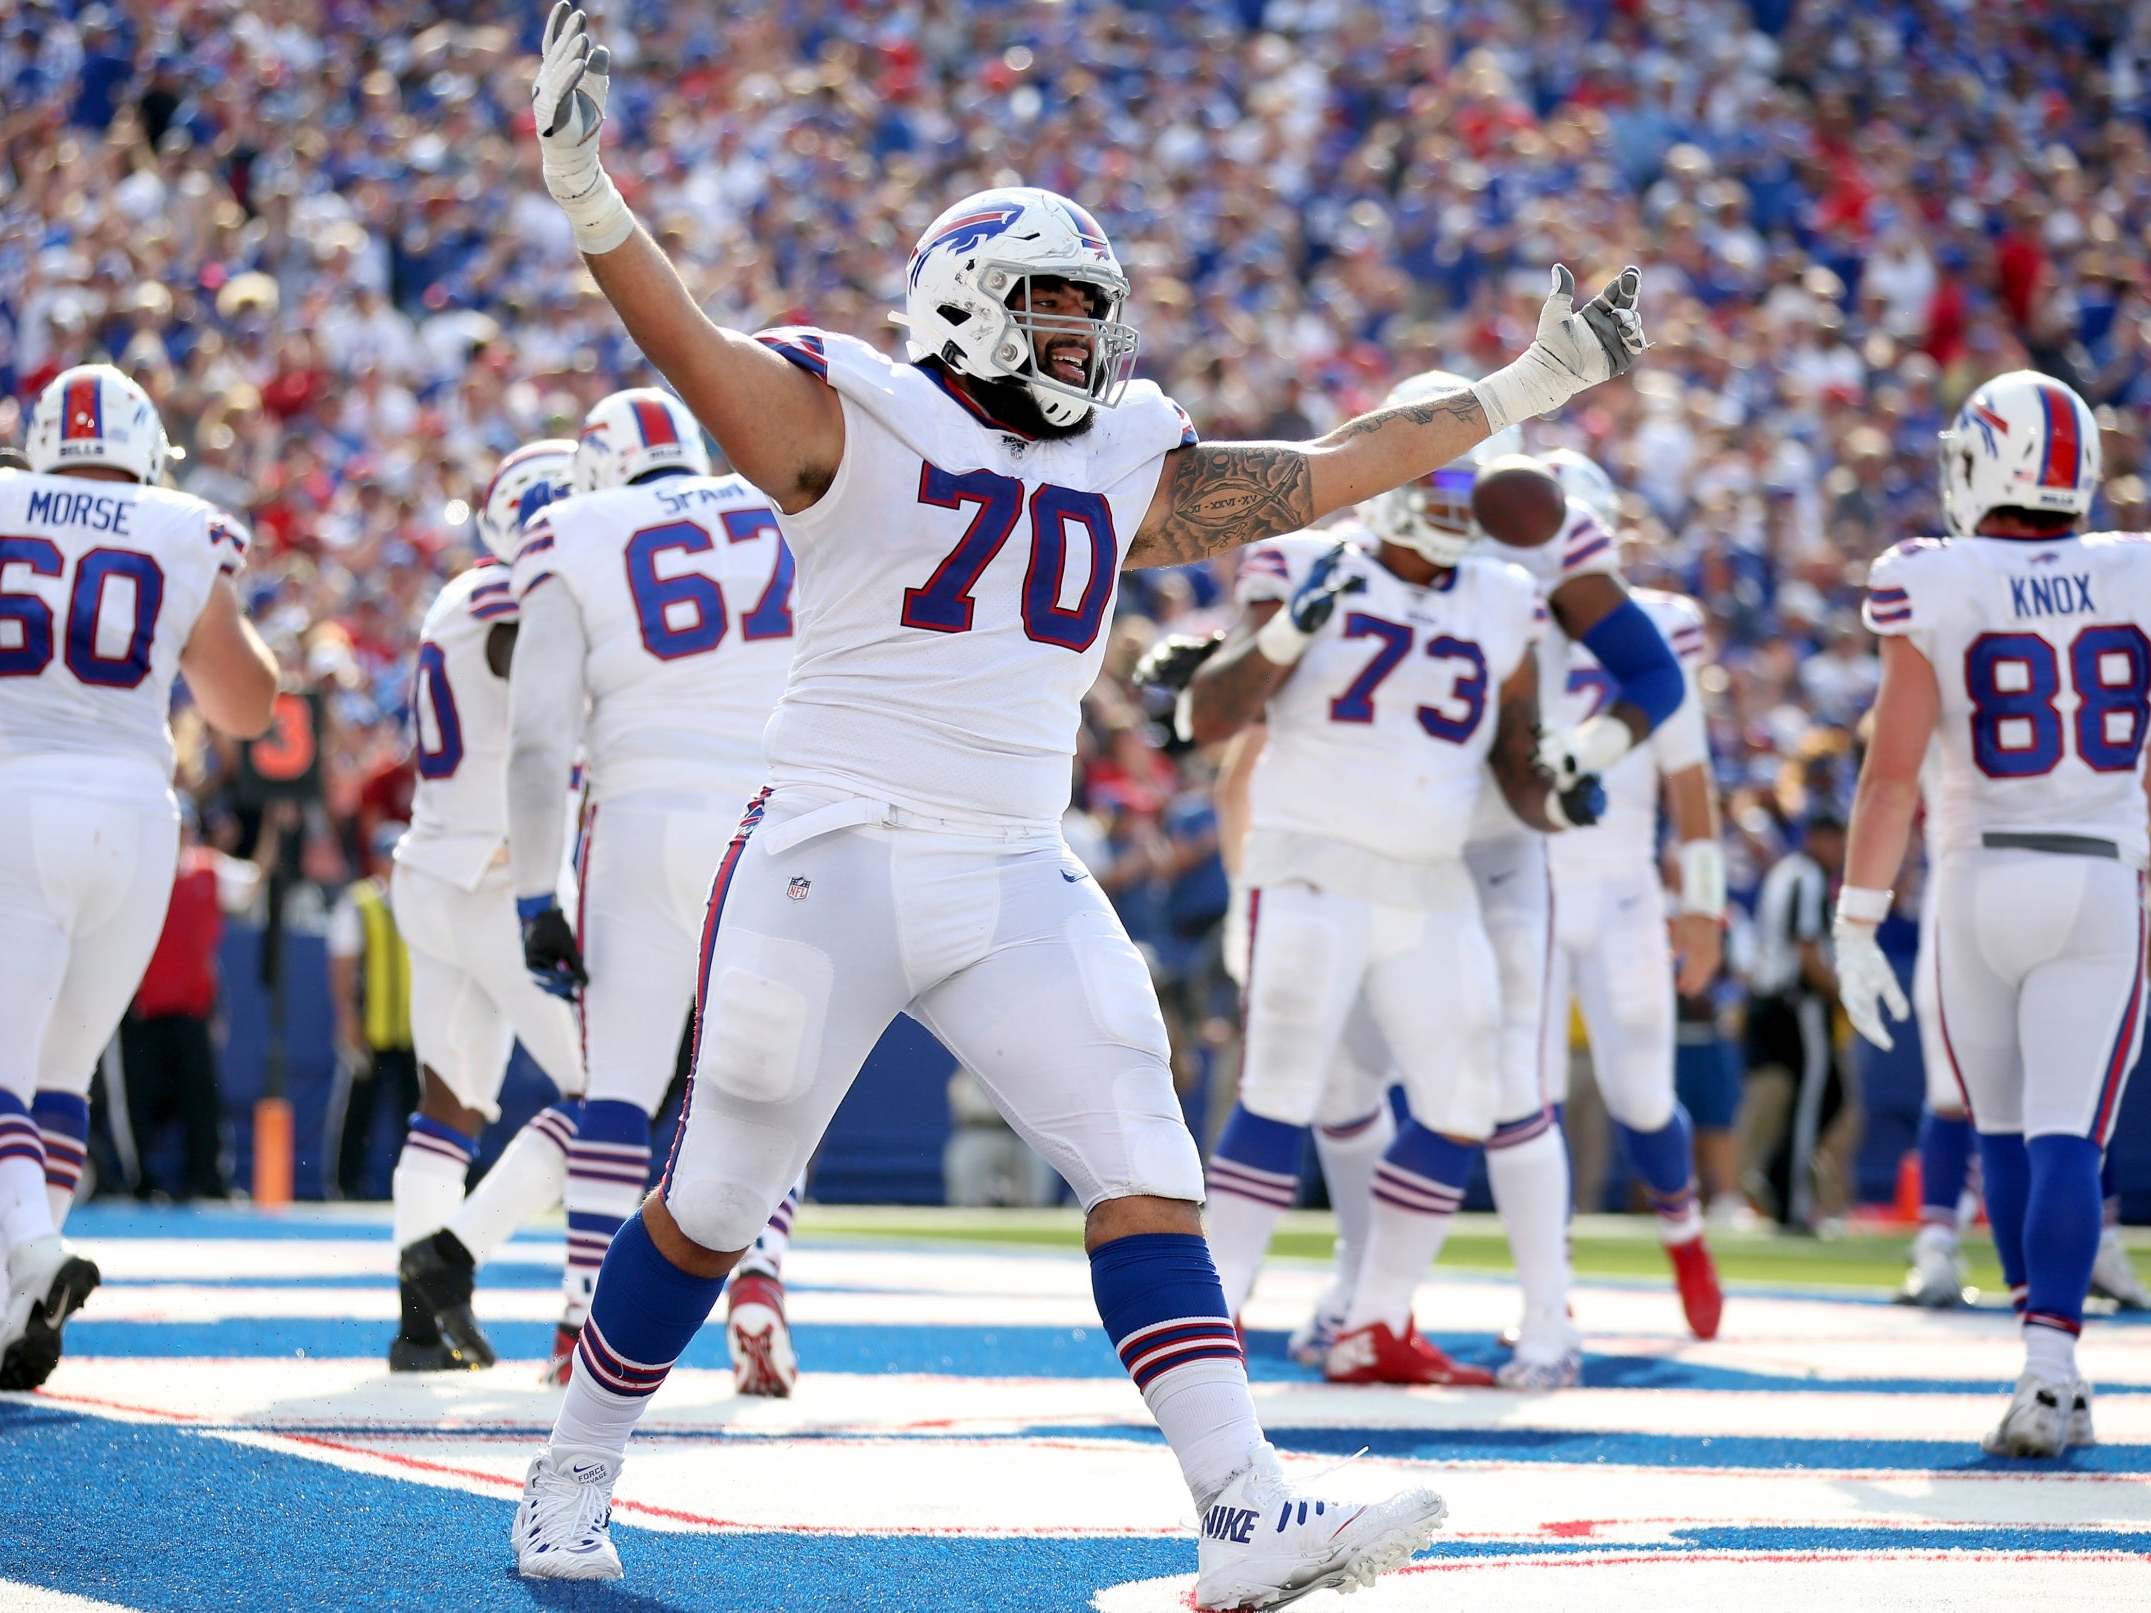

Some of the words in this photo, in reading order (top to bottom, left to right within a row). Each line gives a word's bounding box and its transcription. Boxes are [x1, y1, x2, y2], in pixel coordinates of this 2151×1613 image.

[27, 490, 136, 536] MORSE
[901, 459, 1117, 653] 70
[0, 535, 164, 689] 60
[624, 508, 796, 662] 67
[2010, 573, 2096, 618] KNOX
[1329, 612, 1489, 745] 73
[1964, 623, 2151, 780] 88
[578, 1464, 605, 1481] FORCE
[1200, 1504, 1260, 1544] NIKE
